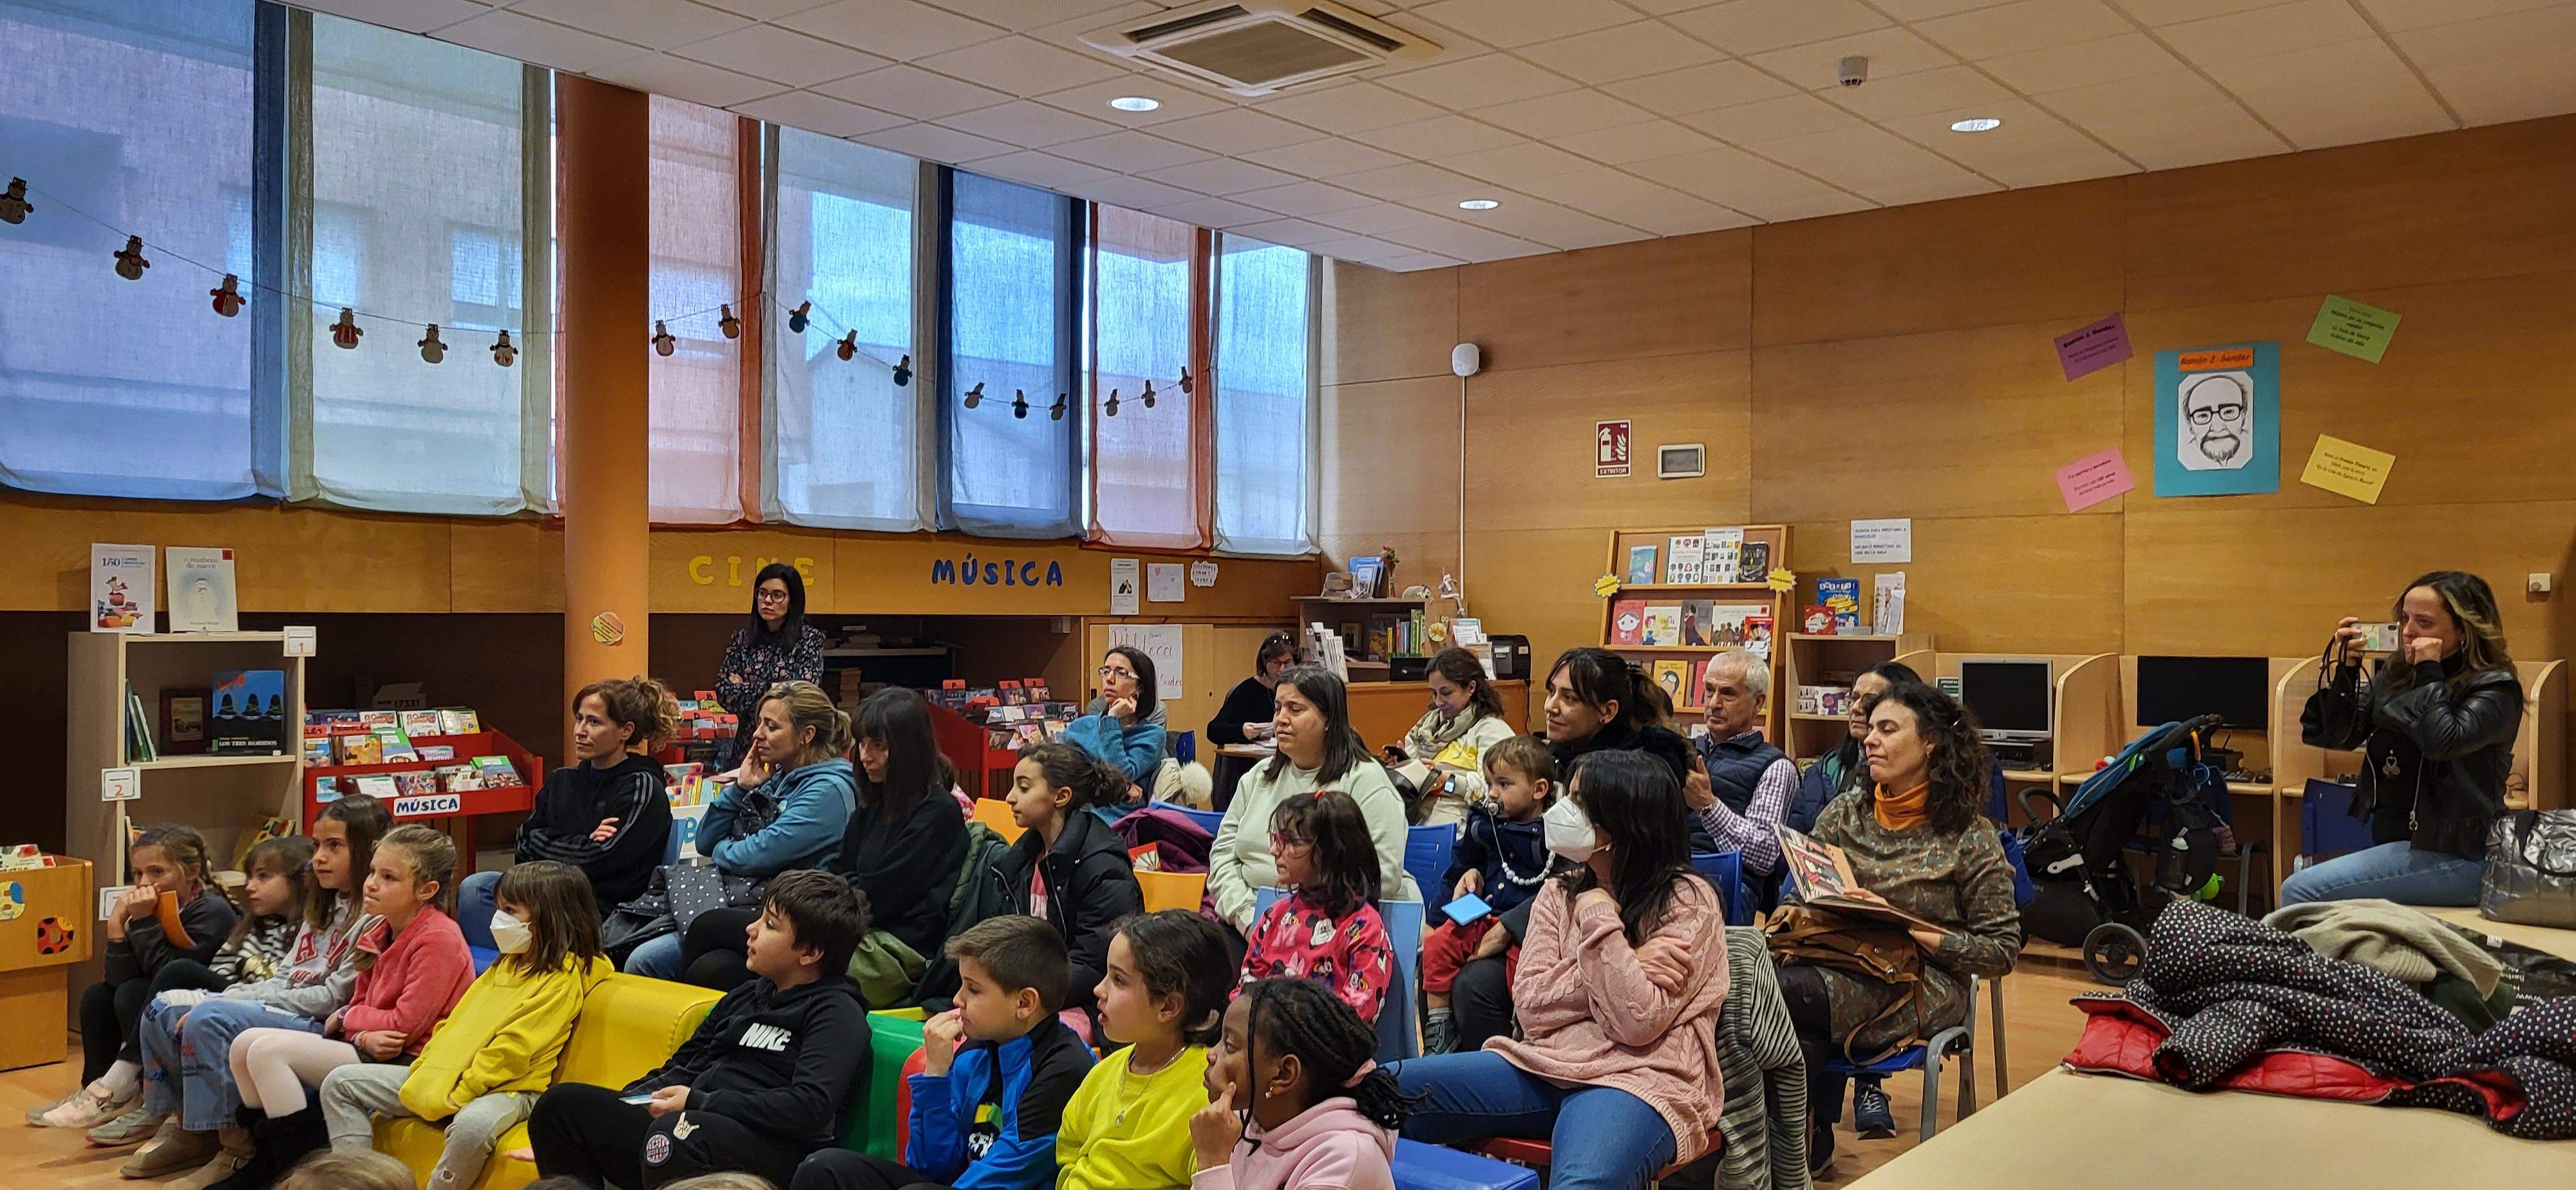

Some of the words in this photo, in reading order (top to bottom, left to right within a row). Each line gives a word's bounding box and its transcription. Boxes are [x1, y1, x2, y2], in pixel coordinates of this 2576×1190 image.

[102, 557, 121, 567] 150
[931, 552, 1063, 587] MÚSICA
[298, 641, 305, 654] 1
[114, 784, 124, 797] 2
[396, 797, 459, 814] MÚSICA
[739, 1022, 791, 1052] NIKE
